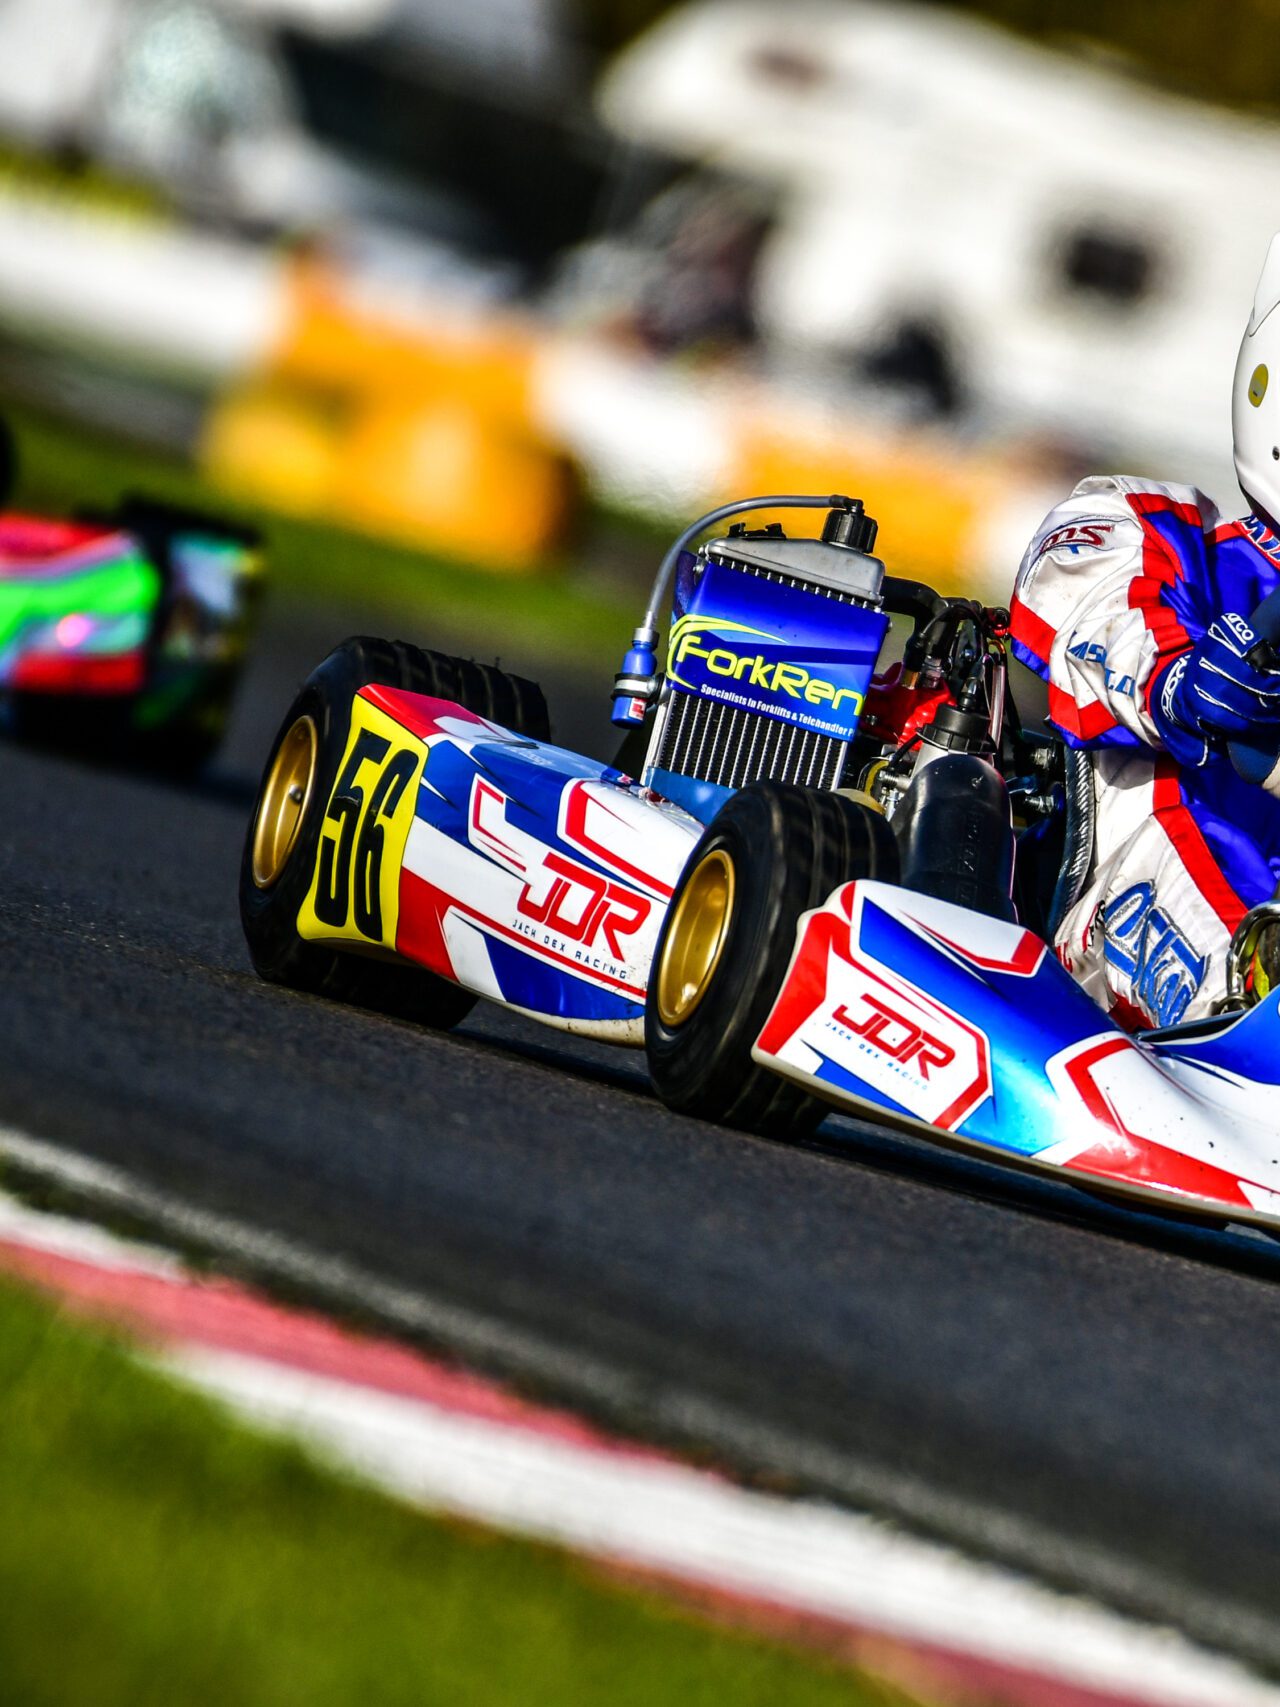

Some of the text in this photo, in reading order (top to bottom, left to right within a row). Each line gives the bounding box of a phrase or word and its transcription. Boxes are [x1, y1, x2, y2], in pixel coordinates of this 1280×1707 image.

[1223, 612, 1255, 641] arco
[675, 634, 866, 716] ForkRen
[700, 683, 747, 706] Specialists
[313, 727, 420, 942] 56
[517, 851, 652, 962] JDR
[512, 919, 628, 980] JACK DEX RACING
[832, 993, 956, 1081] JDR
